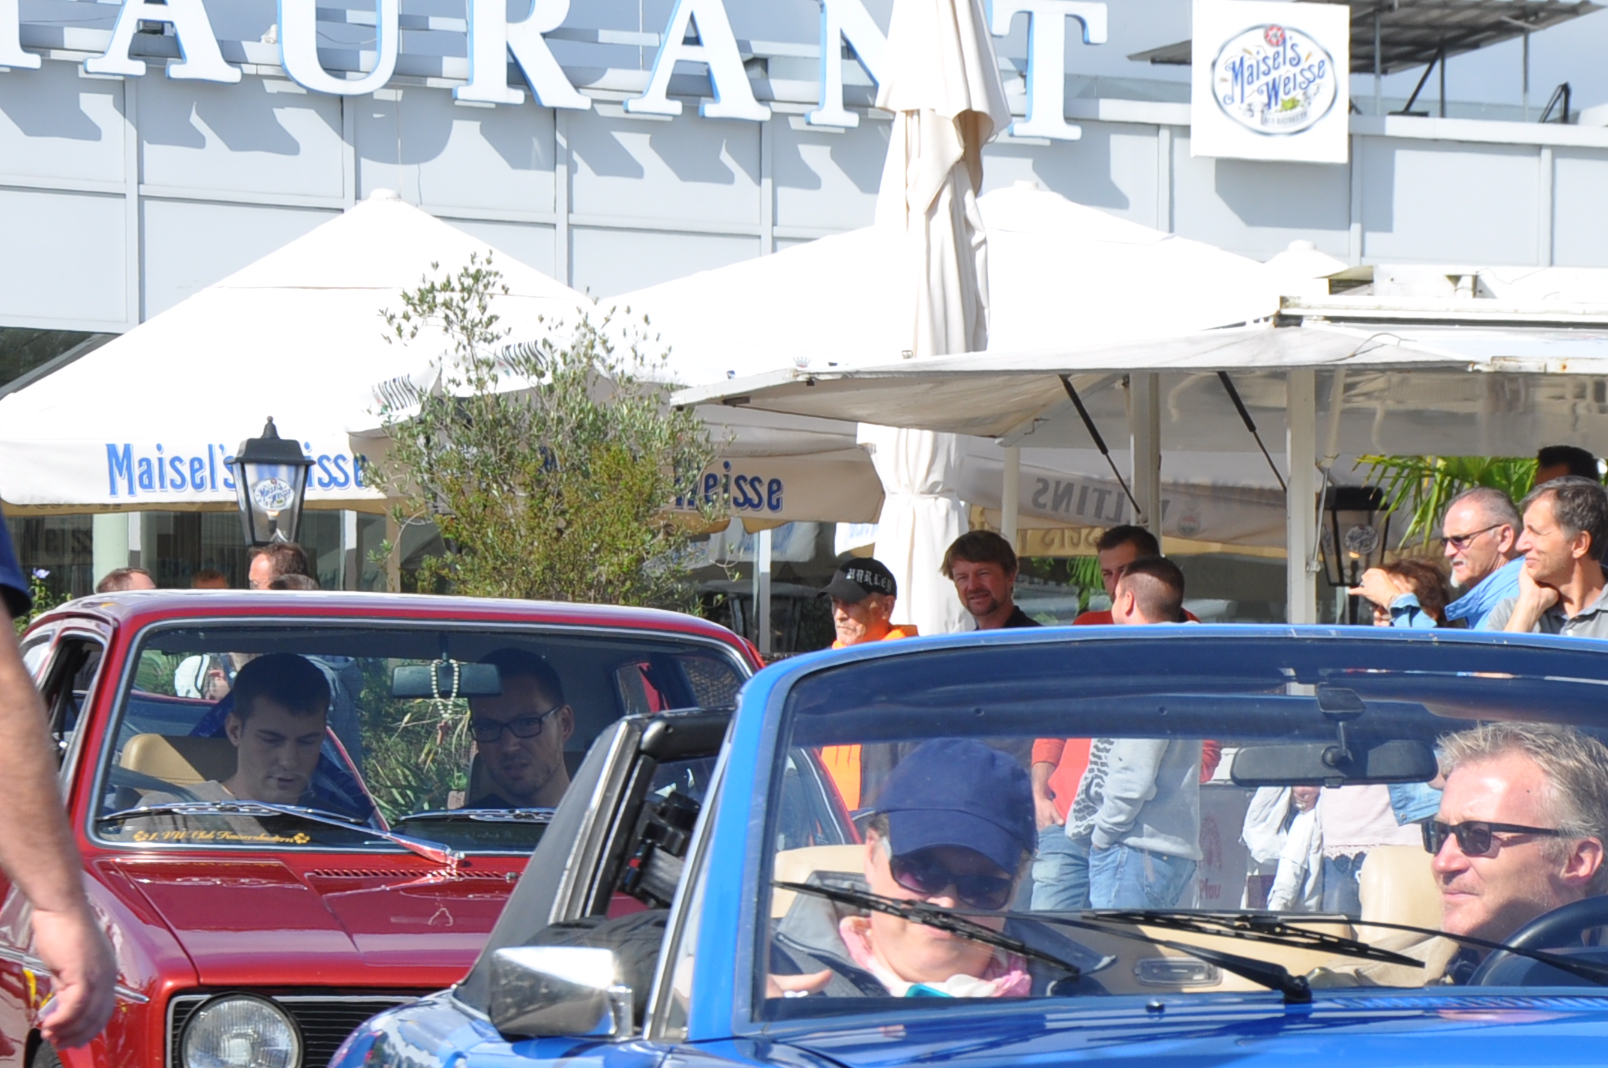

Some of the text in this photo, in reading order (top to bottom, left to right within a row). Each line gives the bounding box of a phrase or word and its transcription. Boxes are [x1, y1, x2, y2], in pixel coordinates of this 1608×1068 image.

[0, 0, 1108, 140] AURANT
[1223, 36, 1301, 105] Maisel's
[1257, 59, 1326, 110] Weisse
